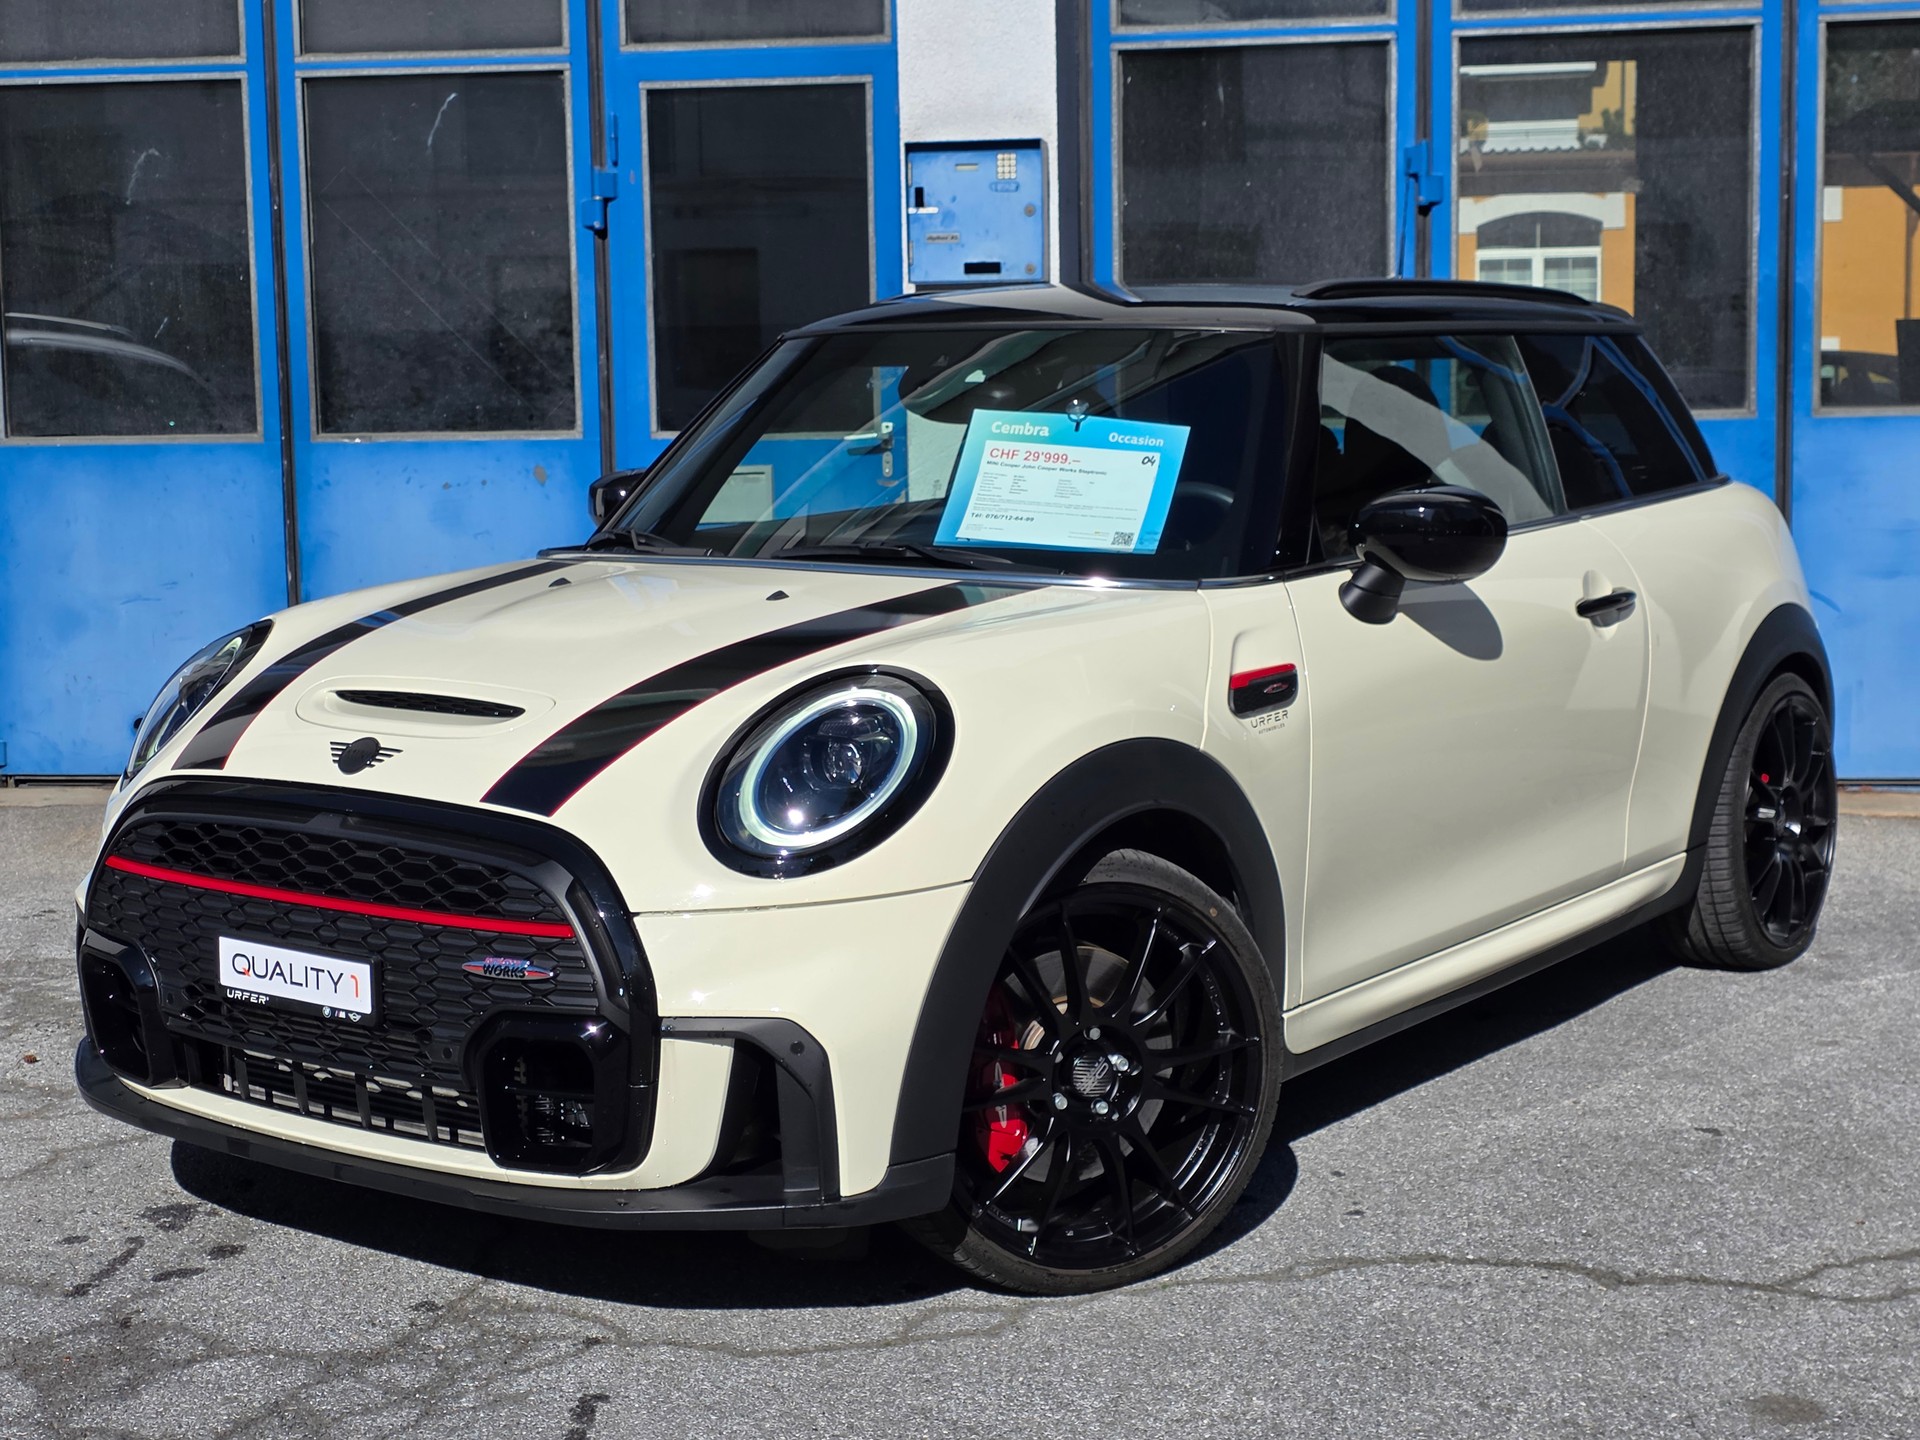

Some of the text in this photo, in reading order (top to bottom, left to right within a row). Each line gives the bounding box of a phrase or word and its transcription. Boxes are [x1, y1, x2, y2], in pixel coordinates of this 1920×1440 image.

[991, 420, 1050, 437] Cembra
[1108, 432, 1164, 447] Occasion
[989, 447, 1020, 461] CHF
[1141, 455, 1156, 467] 04
[1250, 709, 1289, 729] URFER
[482, 963, 527, 979] WORKS
[226, 988, 267, 1005] URFER
